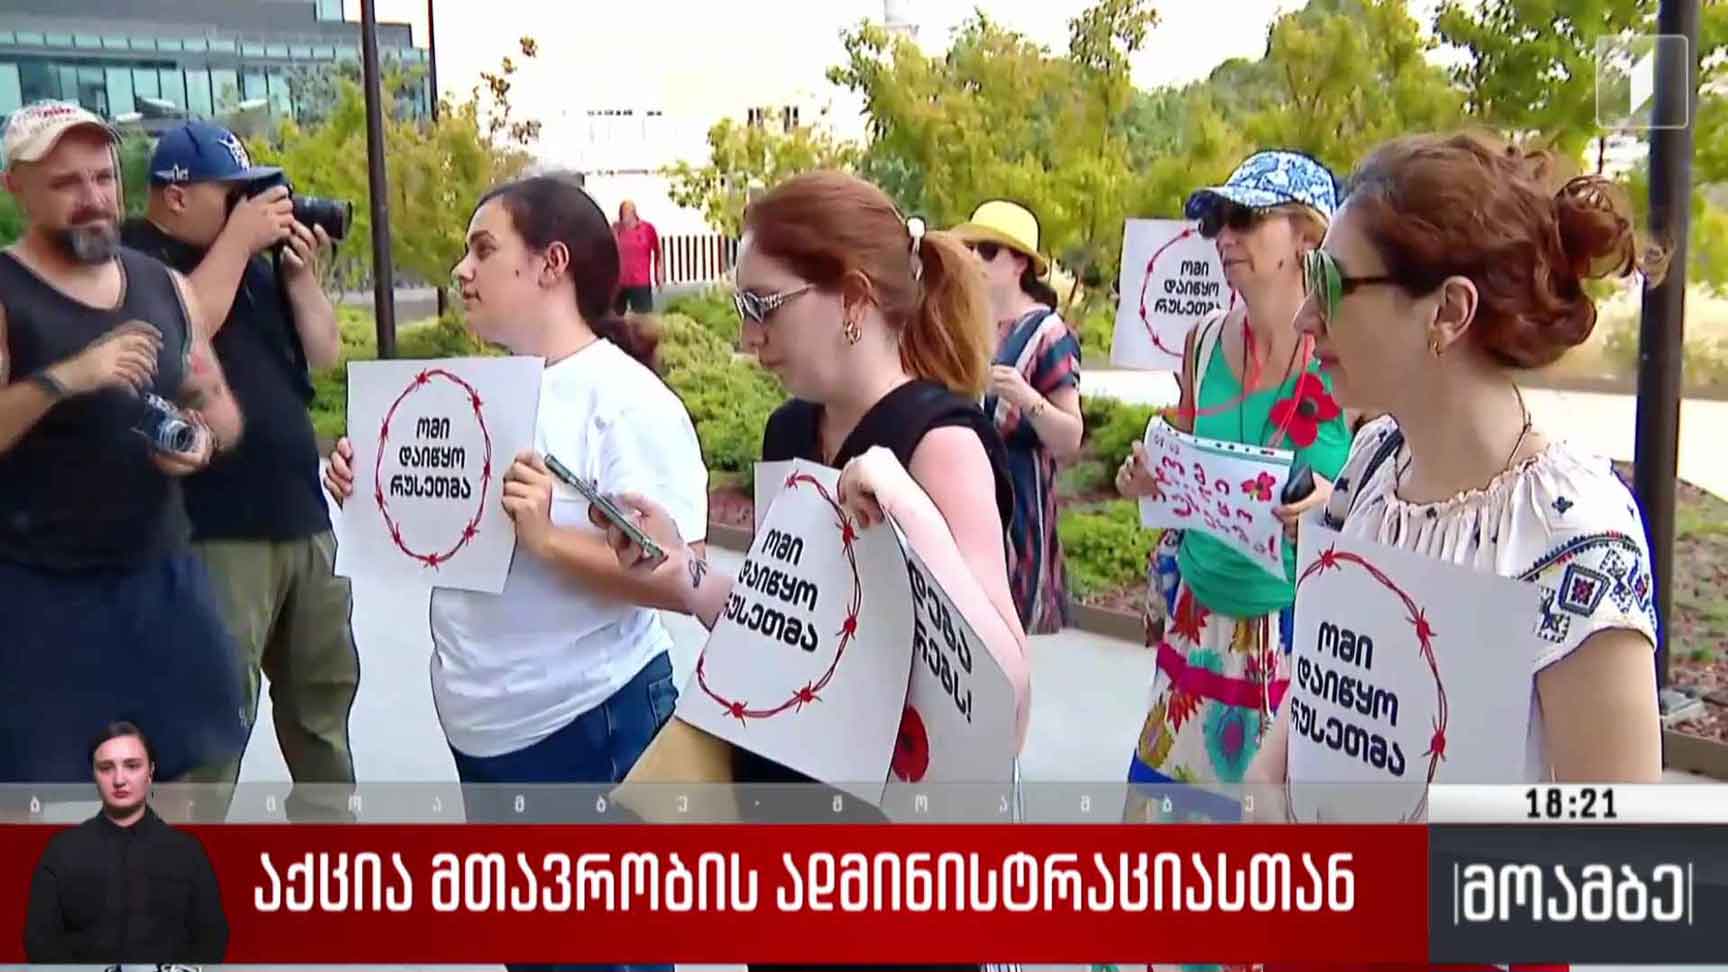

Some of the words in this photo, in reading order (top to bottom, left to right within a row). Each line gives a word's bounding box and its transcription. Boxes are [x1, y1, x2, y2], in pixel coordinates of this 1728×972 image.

[1180, 260, 1210, 277] ომი
[1163, 279, 1220, 297] დაიწყო
[416, 417, 450, 440] ომი
[398, 446, 466, 469] დაიწყო
[390, 474, 472, 499] რუსეთმა
[761, 529, 804, 566] ომი
[738, 559, 818, 612] დაიწყო
[1317, 621, 1374, 671] ომი
[1297, 655, 1399, 727] დაიწყო
[1290, 696, 1406, 777] რუსეთმა
